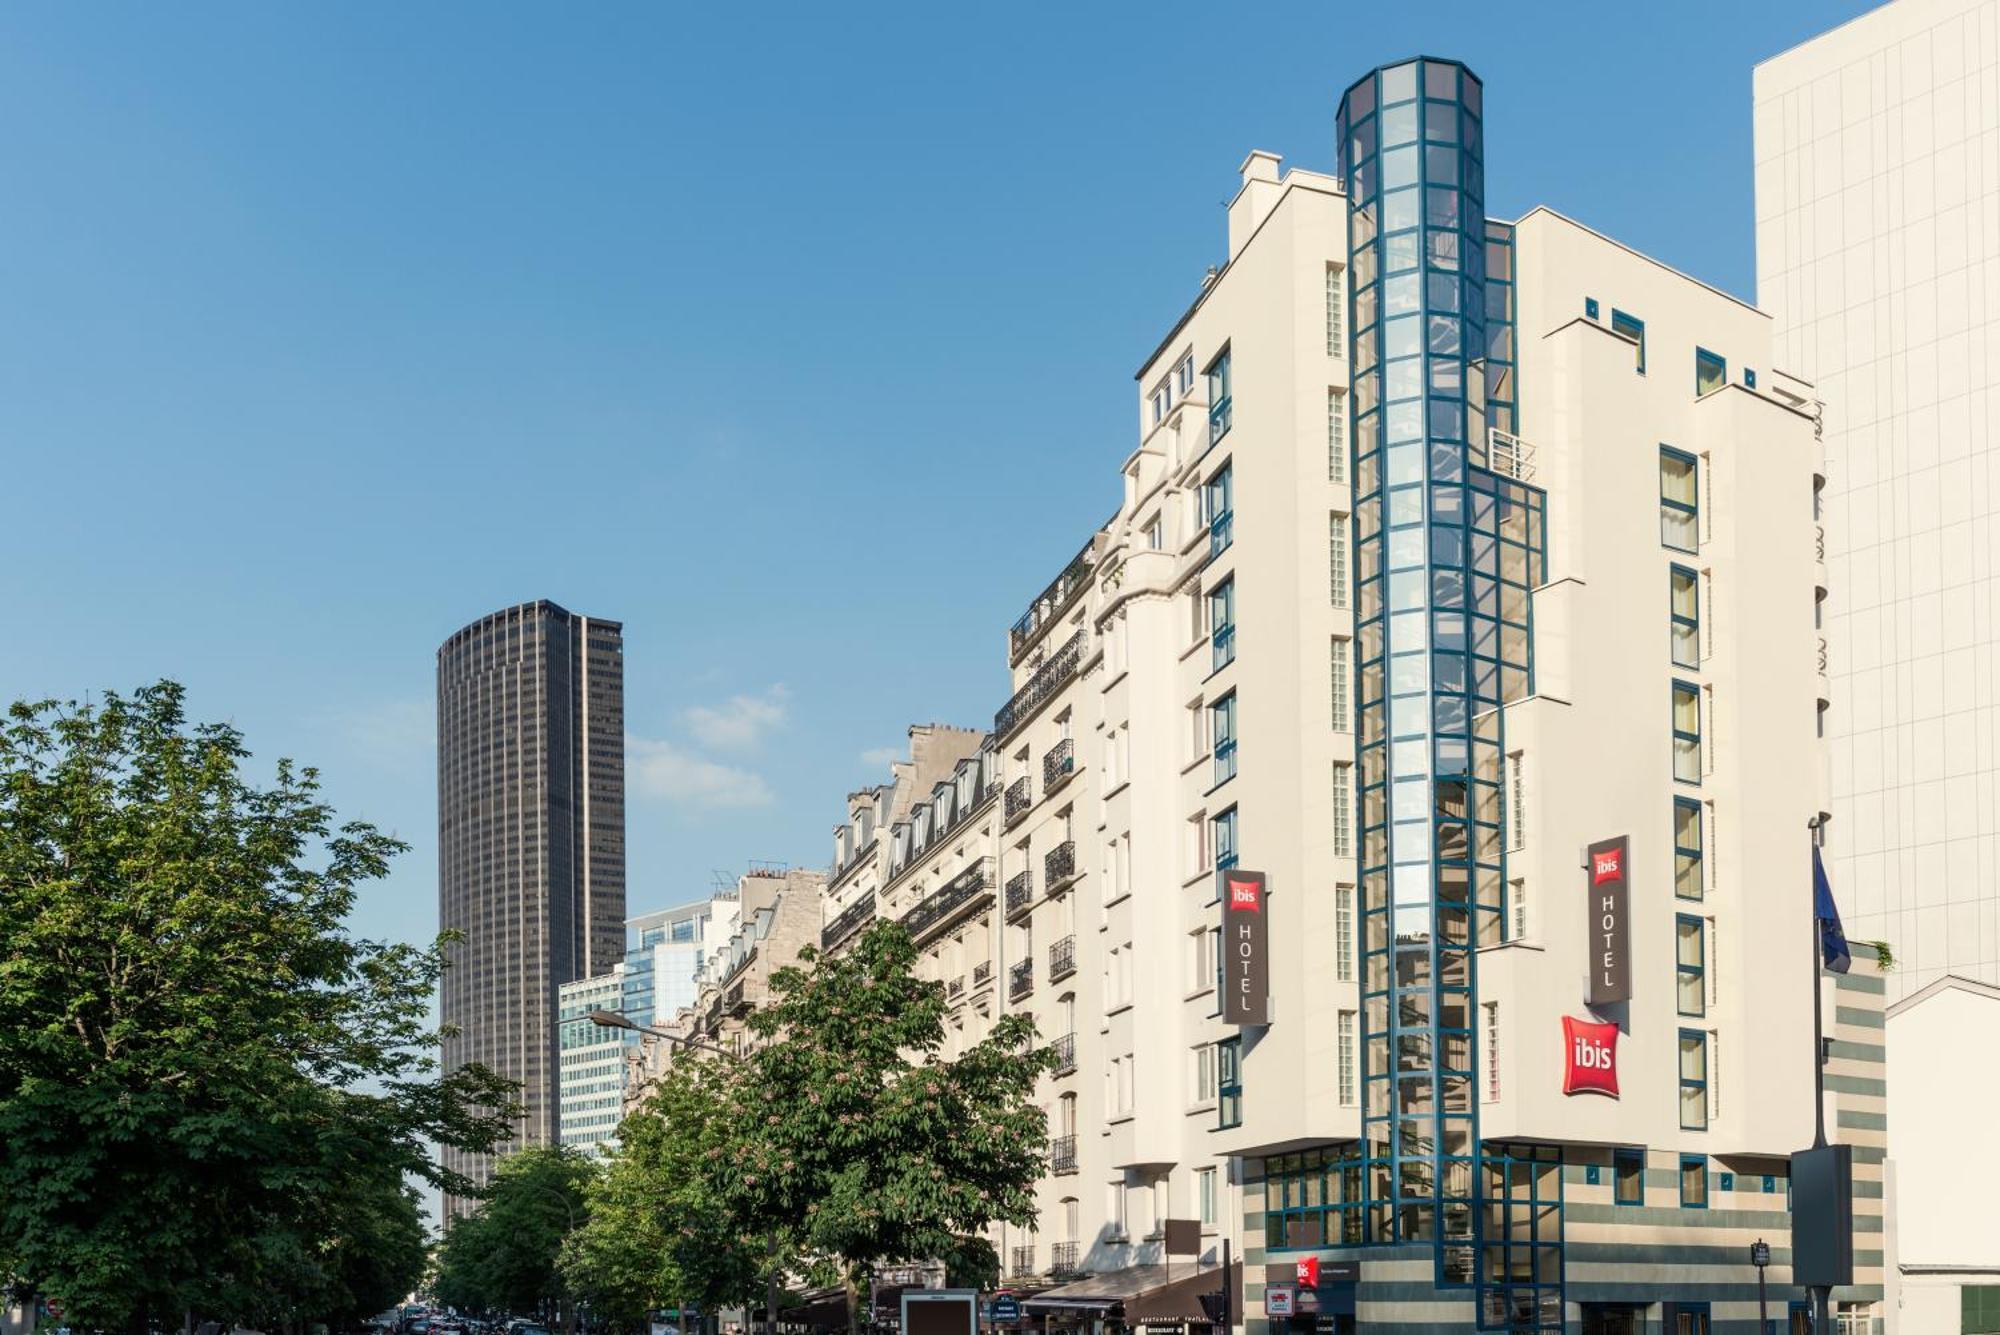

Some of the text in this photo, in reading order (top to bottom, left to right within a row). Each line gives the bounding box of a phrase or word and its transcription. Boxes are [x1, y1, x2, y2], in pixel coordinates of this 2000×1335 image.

[1597, 858, 1618, 874] ibis
[1233, 888, 1255, 902] ibis
[1602, 895, 1614, 987] HOTEL
[1239, 924, 1252, 1011] HOTEL
[1575, 1037, 1611, 1069] ibis
